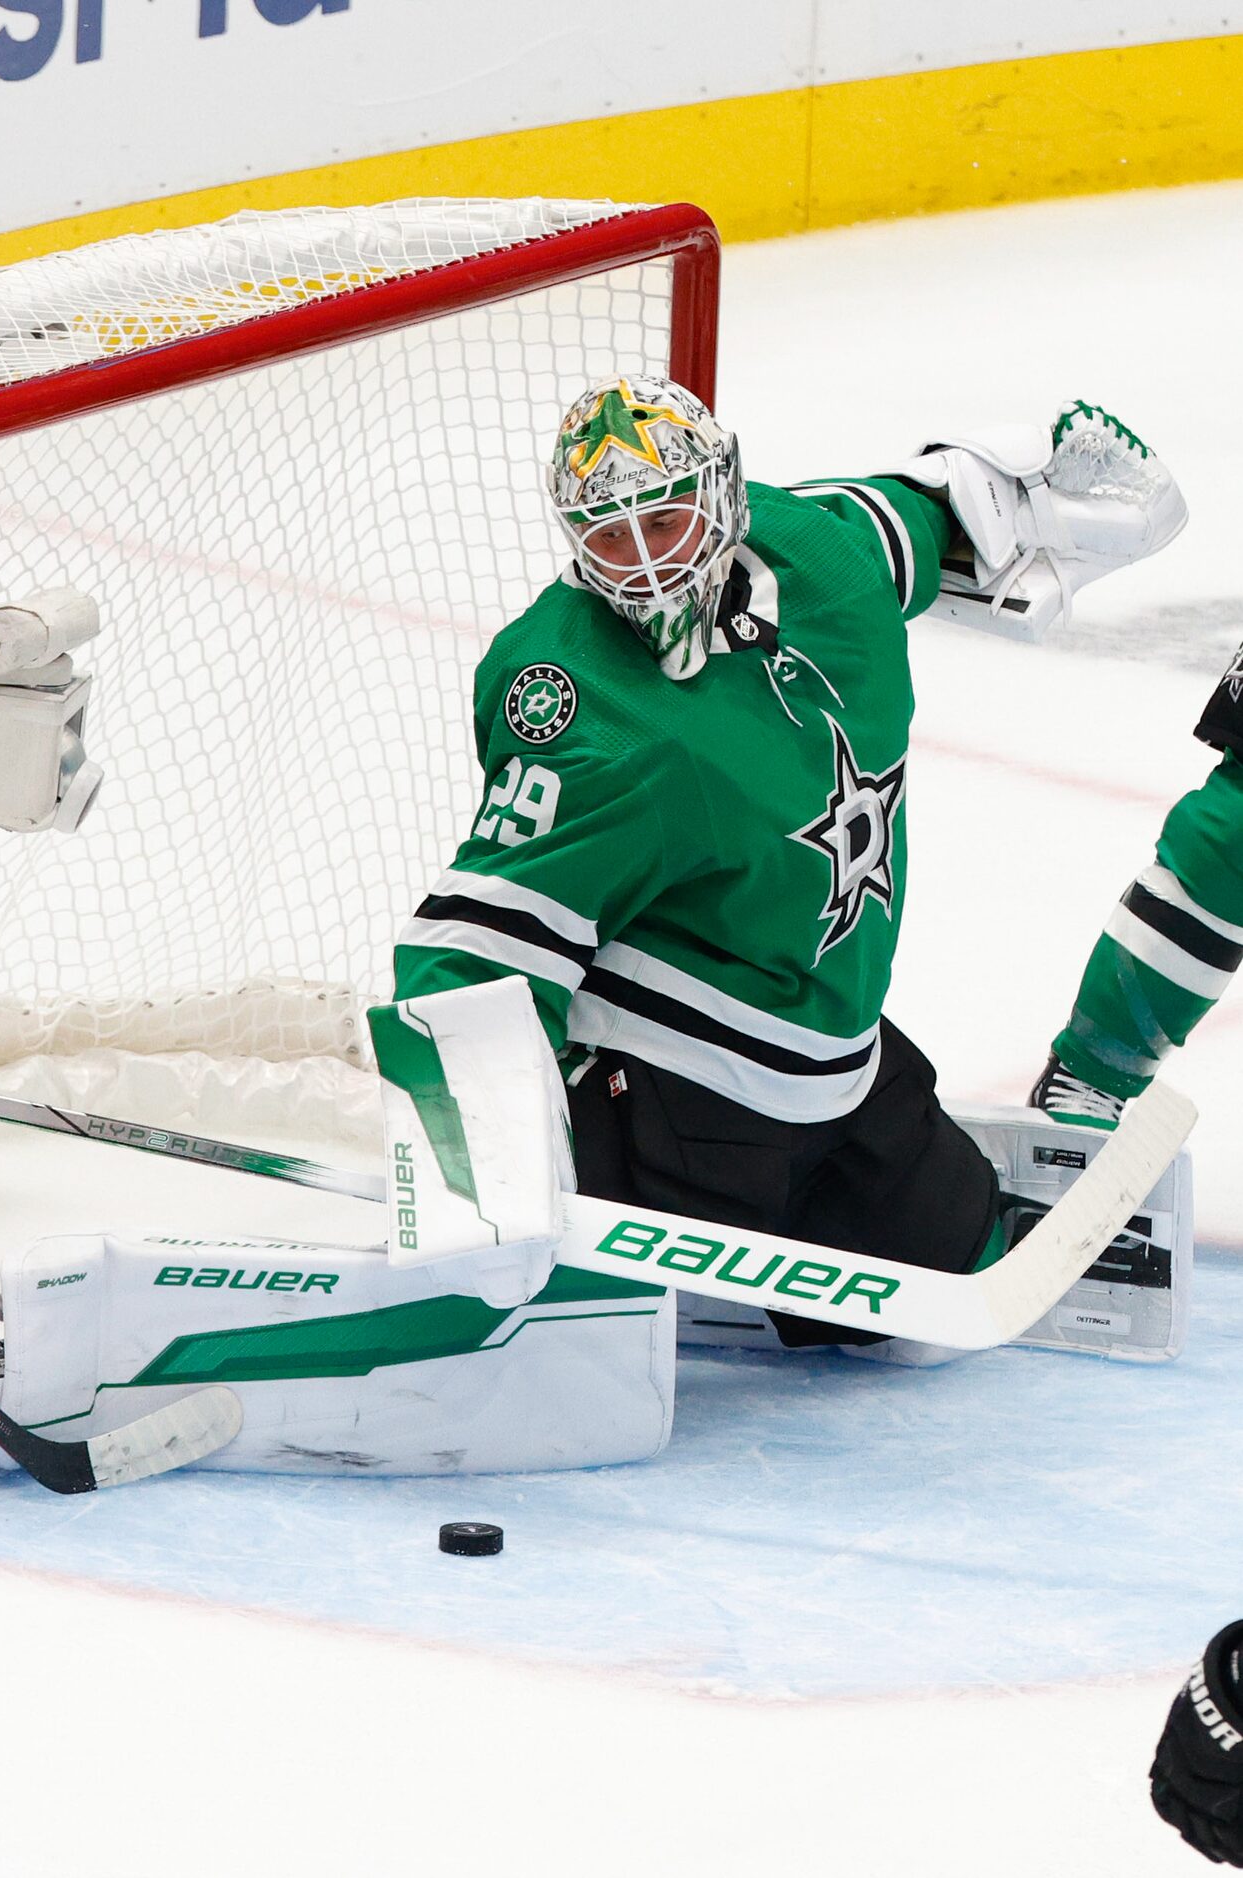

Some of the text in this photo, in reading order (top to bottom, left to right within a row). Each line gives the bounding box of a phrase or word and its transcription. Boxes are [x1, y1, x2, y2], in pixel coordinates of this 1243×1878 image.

[513, 668, 572, 701] DALLAS
[511, 712, 564, 739] STARS
[474, 755, 562, 848] 29
[36, 1271, 88, 1290] SHADOW
